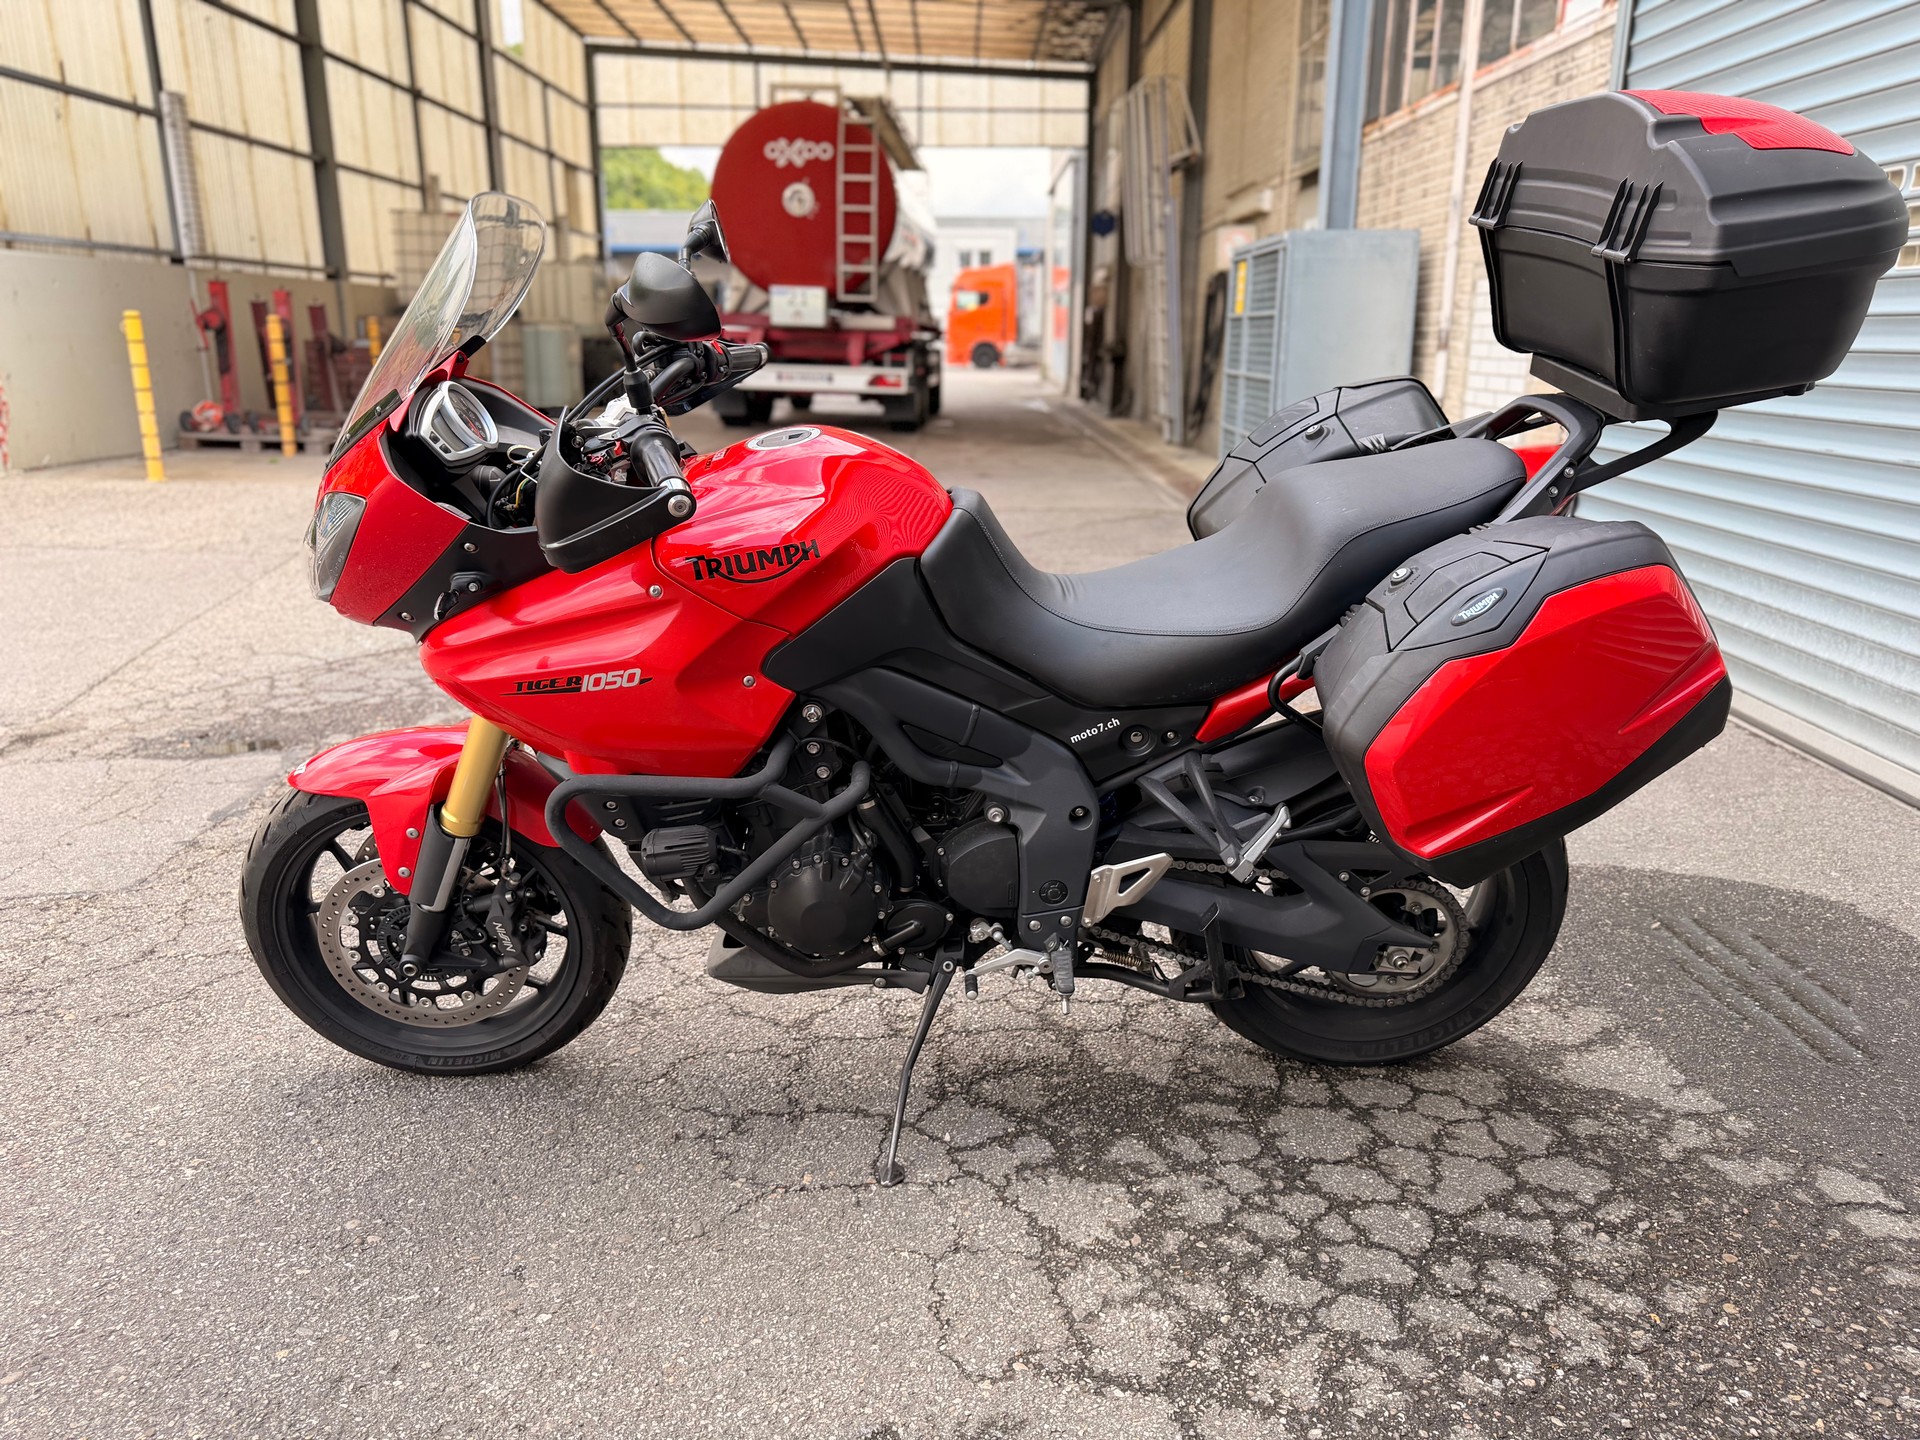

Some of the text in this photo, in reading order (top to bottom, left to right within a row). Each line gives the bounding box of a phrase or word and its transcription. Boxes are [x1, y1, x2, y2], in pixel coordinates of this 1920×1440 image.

[685, 539, 821, 583] TRIUMPH
[1457, 592, 1499, 620] TRIUMPH
[1070, 717, 1121, 744] moto7.ch
[492, 921, 516, 952] NISSIN
[1359, 1010, 1474, 1056] MICHELIN
[426, 1051, 501, 1066] MICHELIN
